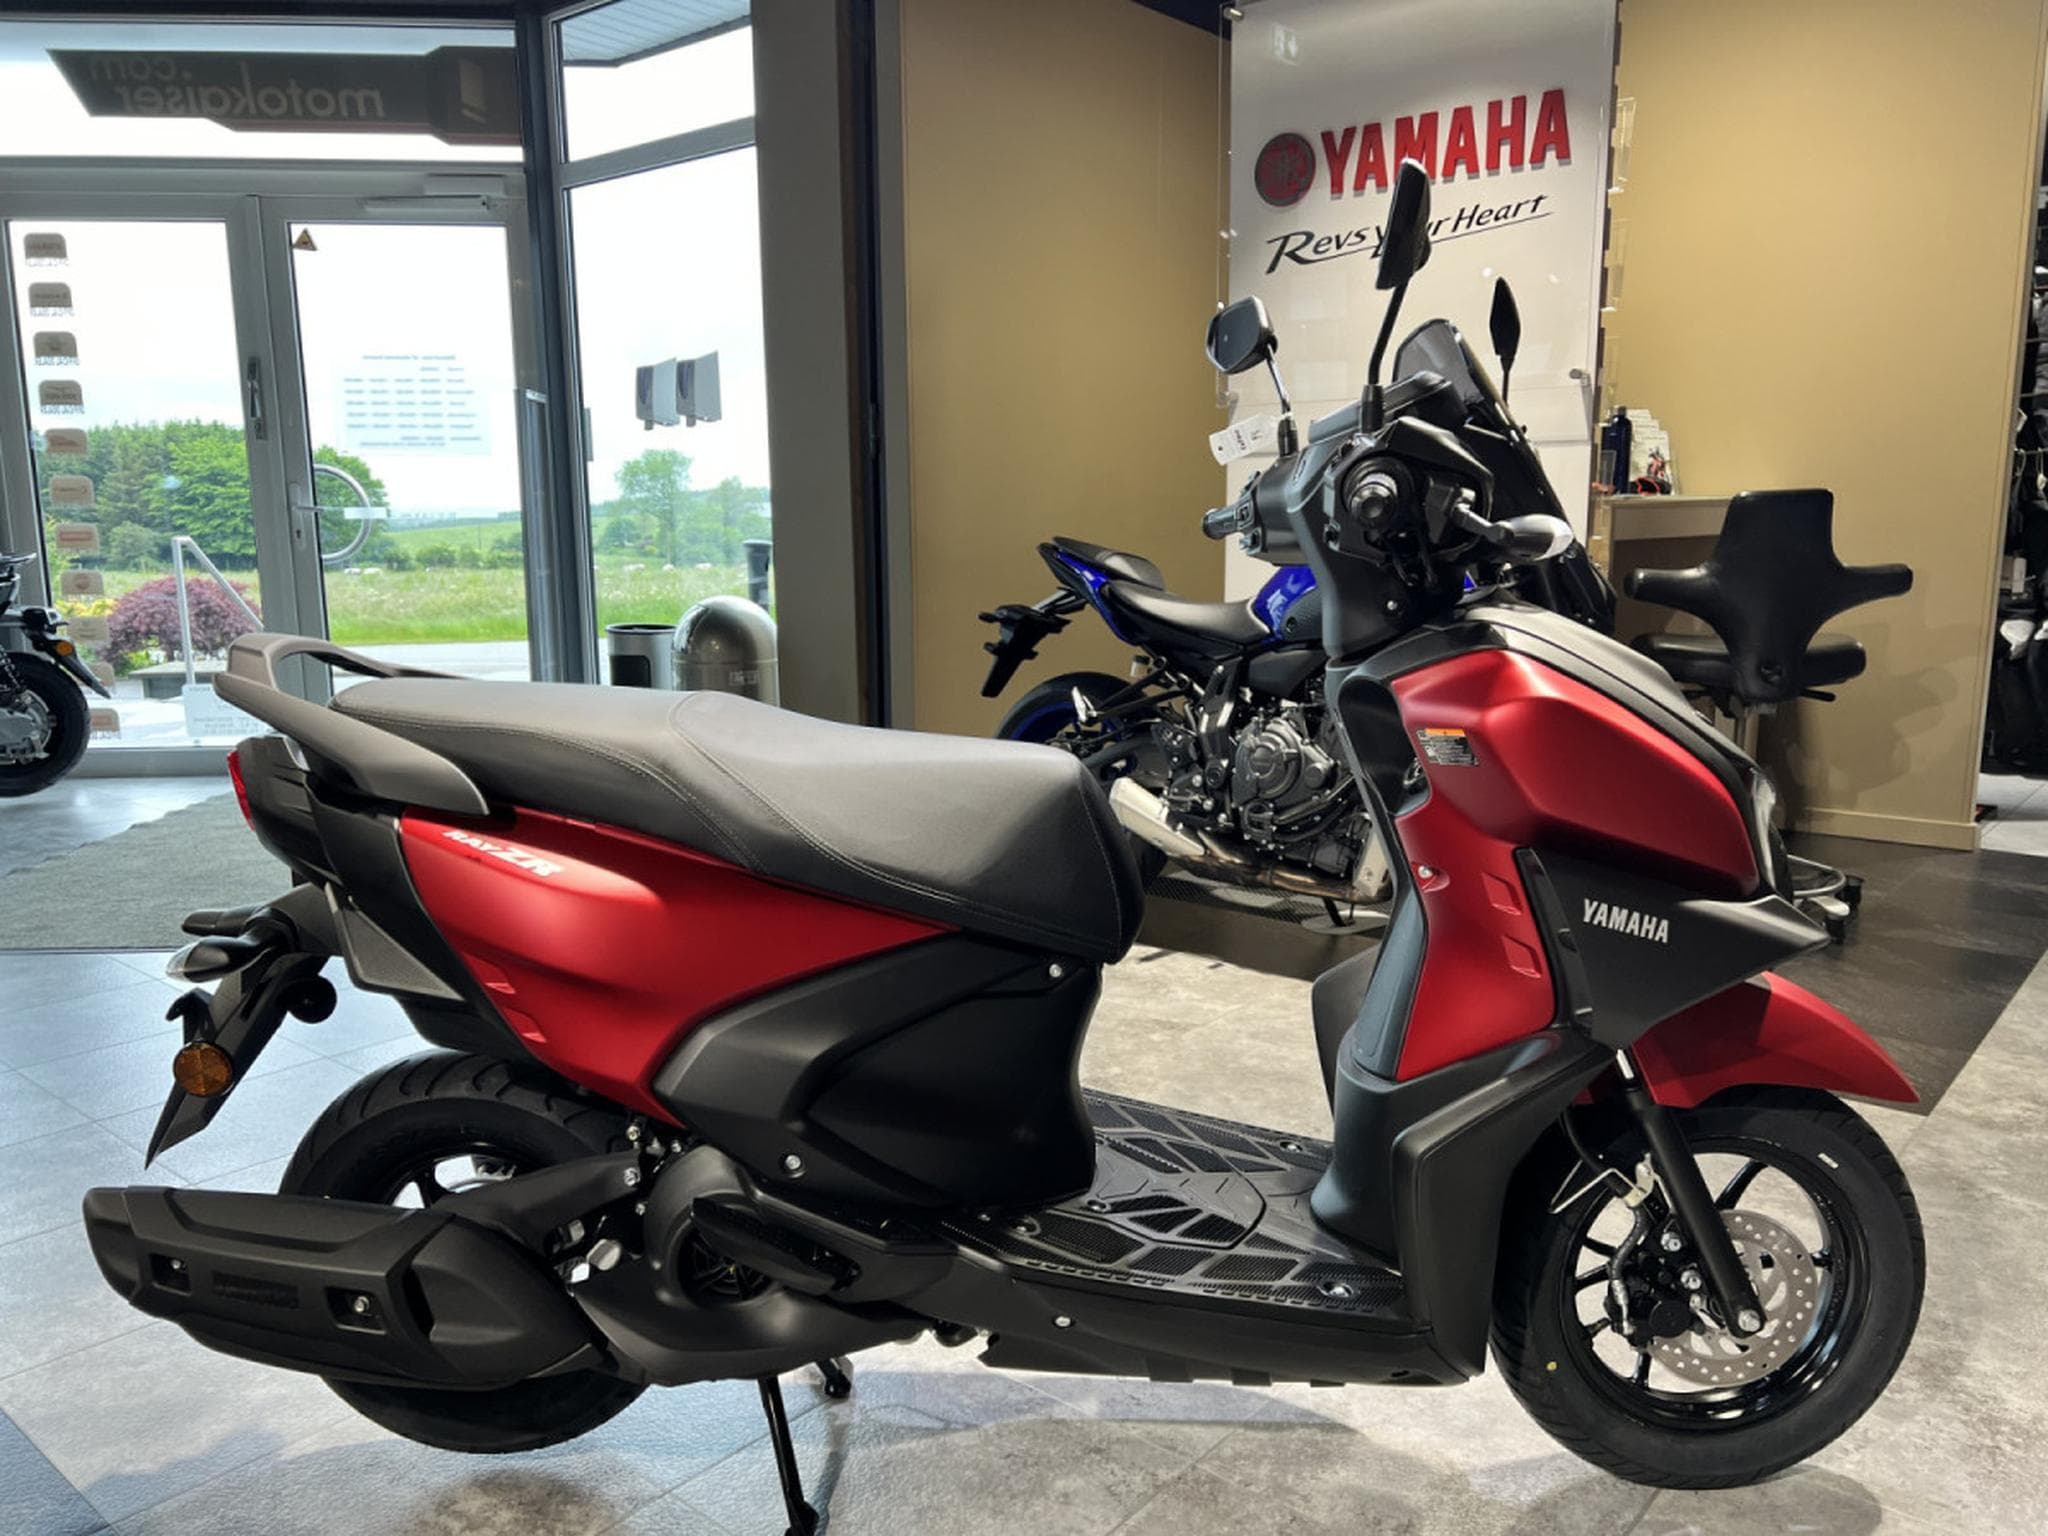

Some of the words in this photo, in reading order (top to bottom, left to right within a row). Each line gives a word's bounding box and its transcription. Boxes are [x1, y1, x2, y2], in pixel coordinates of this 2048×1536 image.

[1320, 88, 1571, 196] YAMAHA
[1265, 226, 1372, 275] Revs
[1369, 215, 1452, 259] Yr
[1451, 194, 1549, 233] Heart
[1583, 898, 1669, 943] YAMAHA
